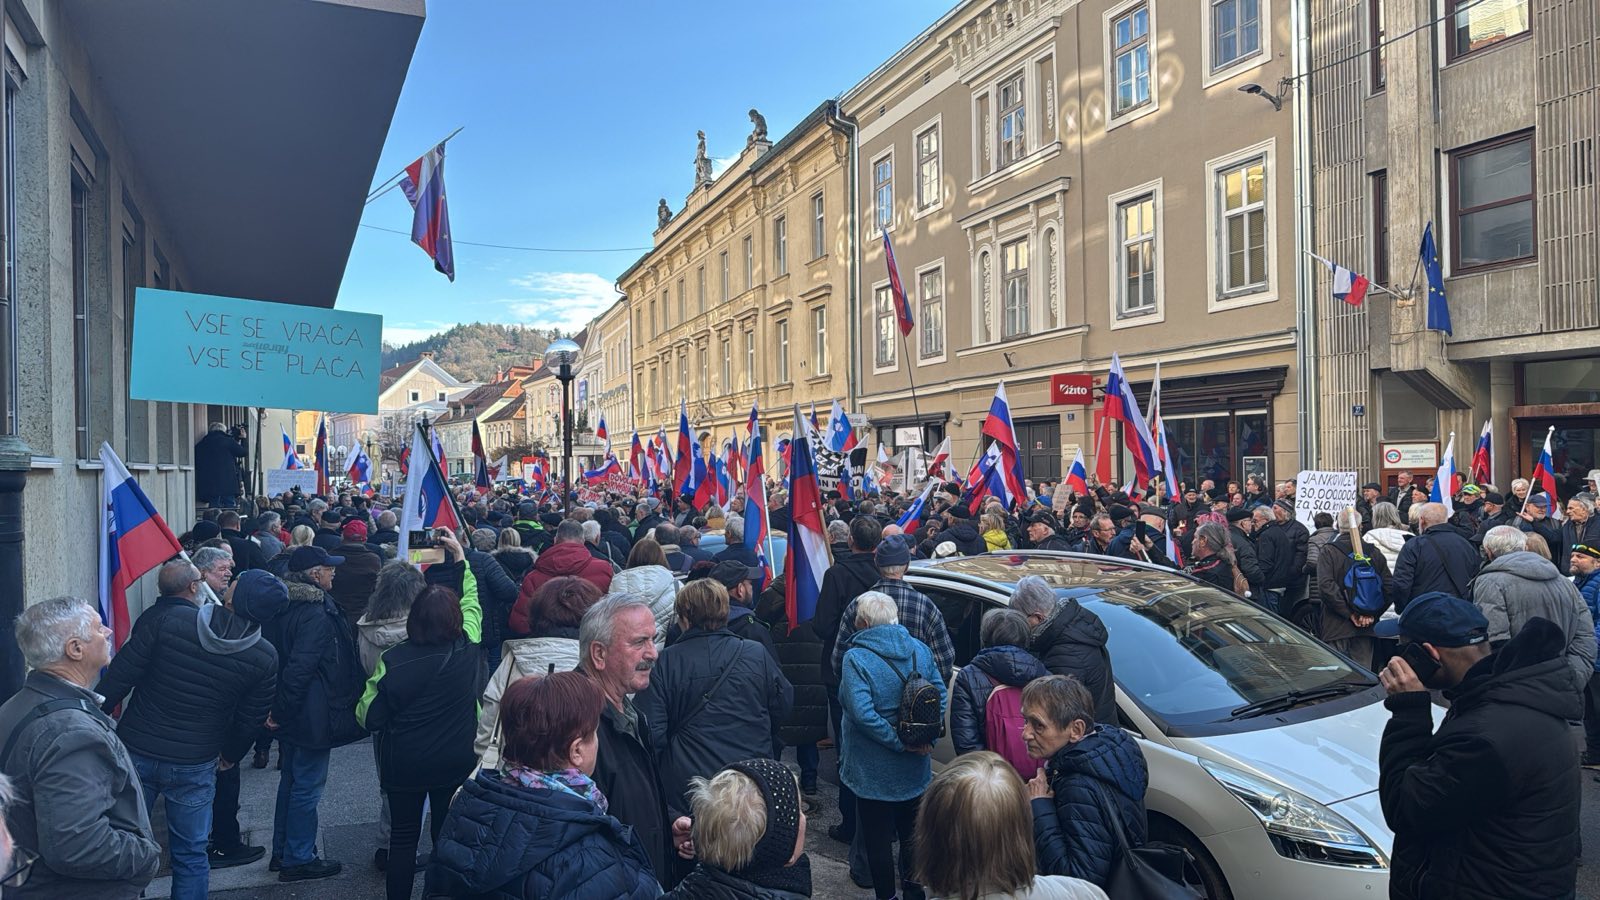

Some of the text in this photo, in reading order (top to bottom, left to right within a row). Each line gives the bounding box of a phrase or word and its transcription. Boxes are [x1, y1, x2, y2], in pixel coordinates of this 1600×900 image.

[185, 310, 232, 336] VSE
[242, 317, 267, 339] SE
[188, 345, 231, 369] VSE
[241, 350, 266, 372] SE
[1296, 500, 1310, 509] za
